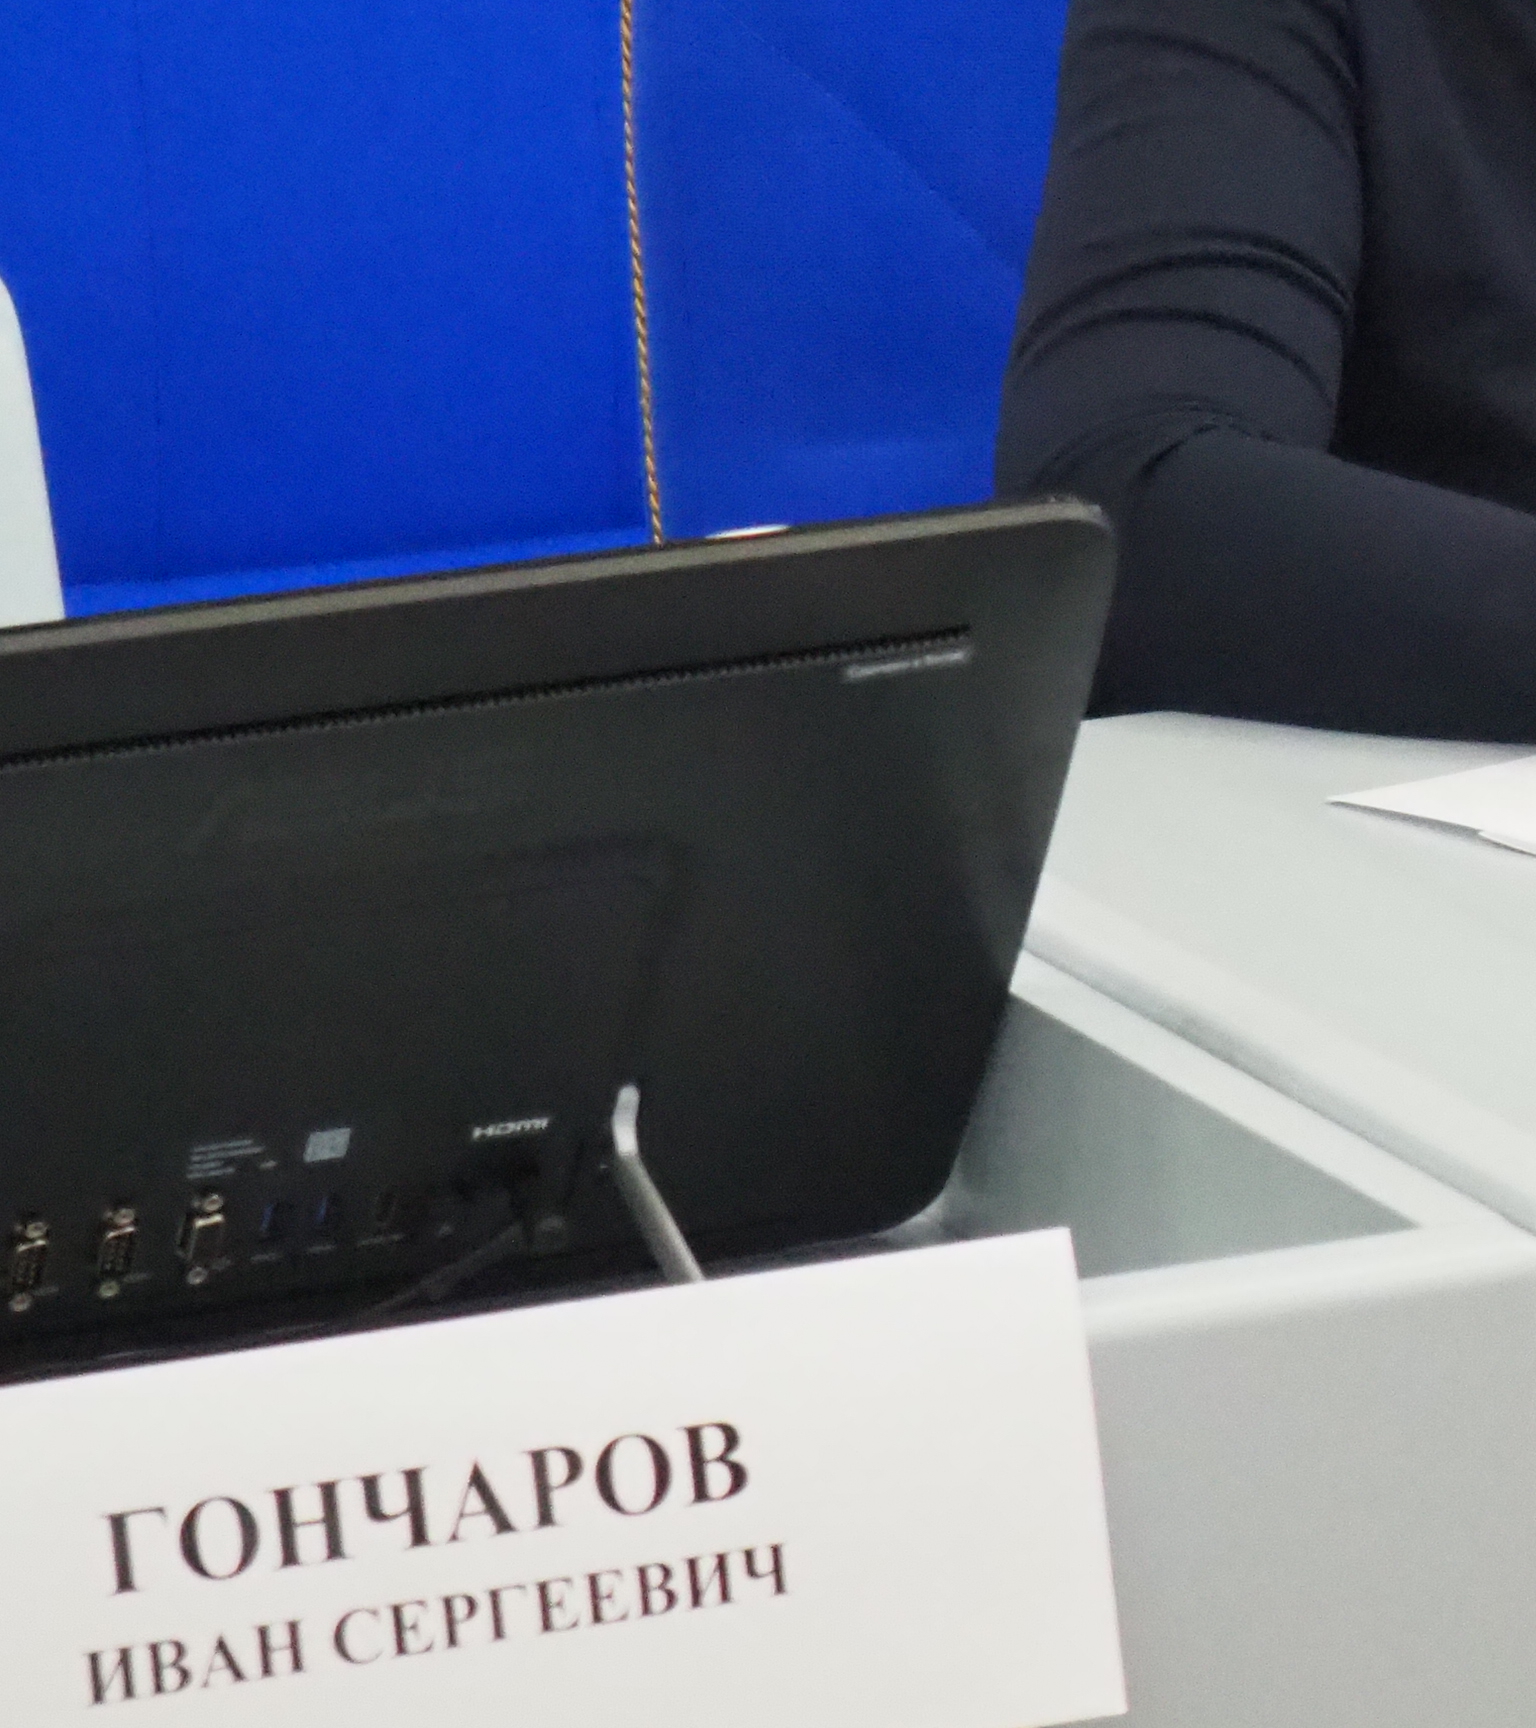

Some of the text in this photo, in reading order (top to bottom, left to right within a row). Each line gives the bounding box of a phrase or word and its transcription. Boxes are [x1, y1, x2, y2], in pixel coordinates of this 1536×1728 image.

[101, 1420, 751, 1597] ГОНЧАРОВ
[82, 1542, 790, 1707] ИВАН СЕРГЕЕВИЧ
